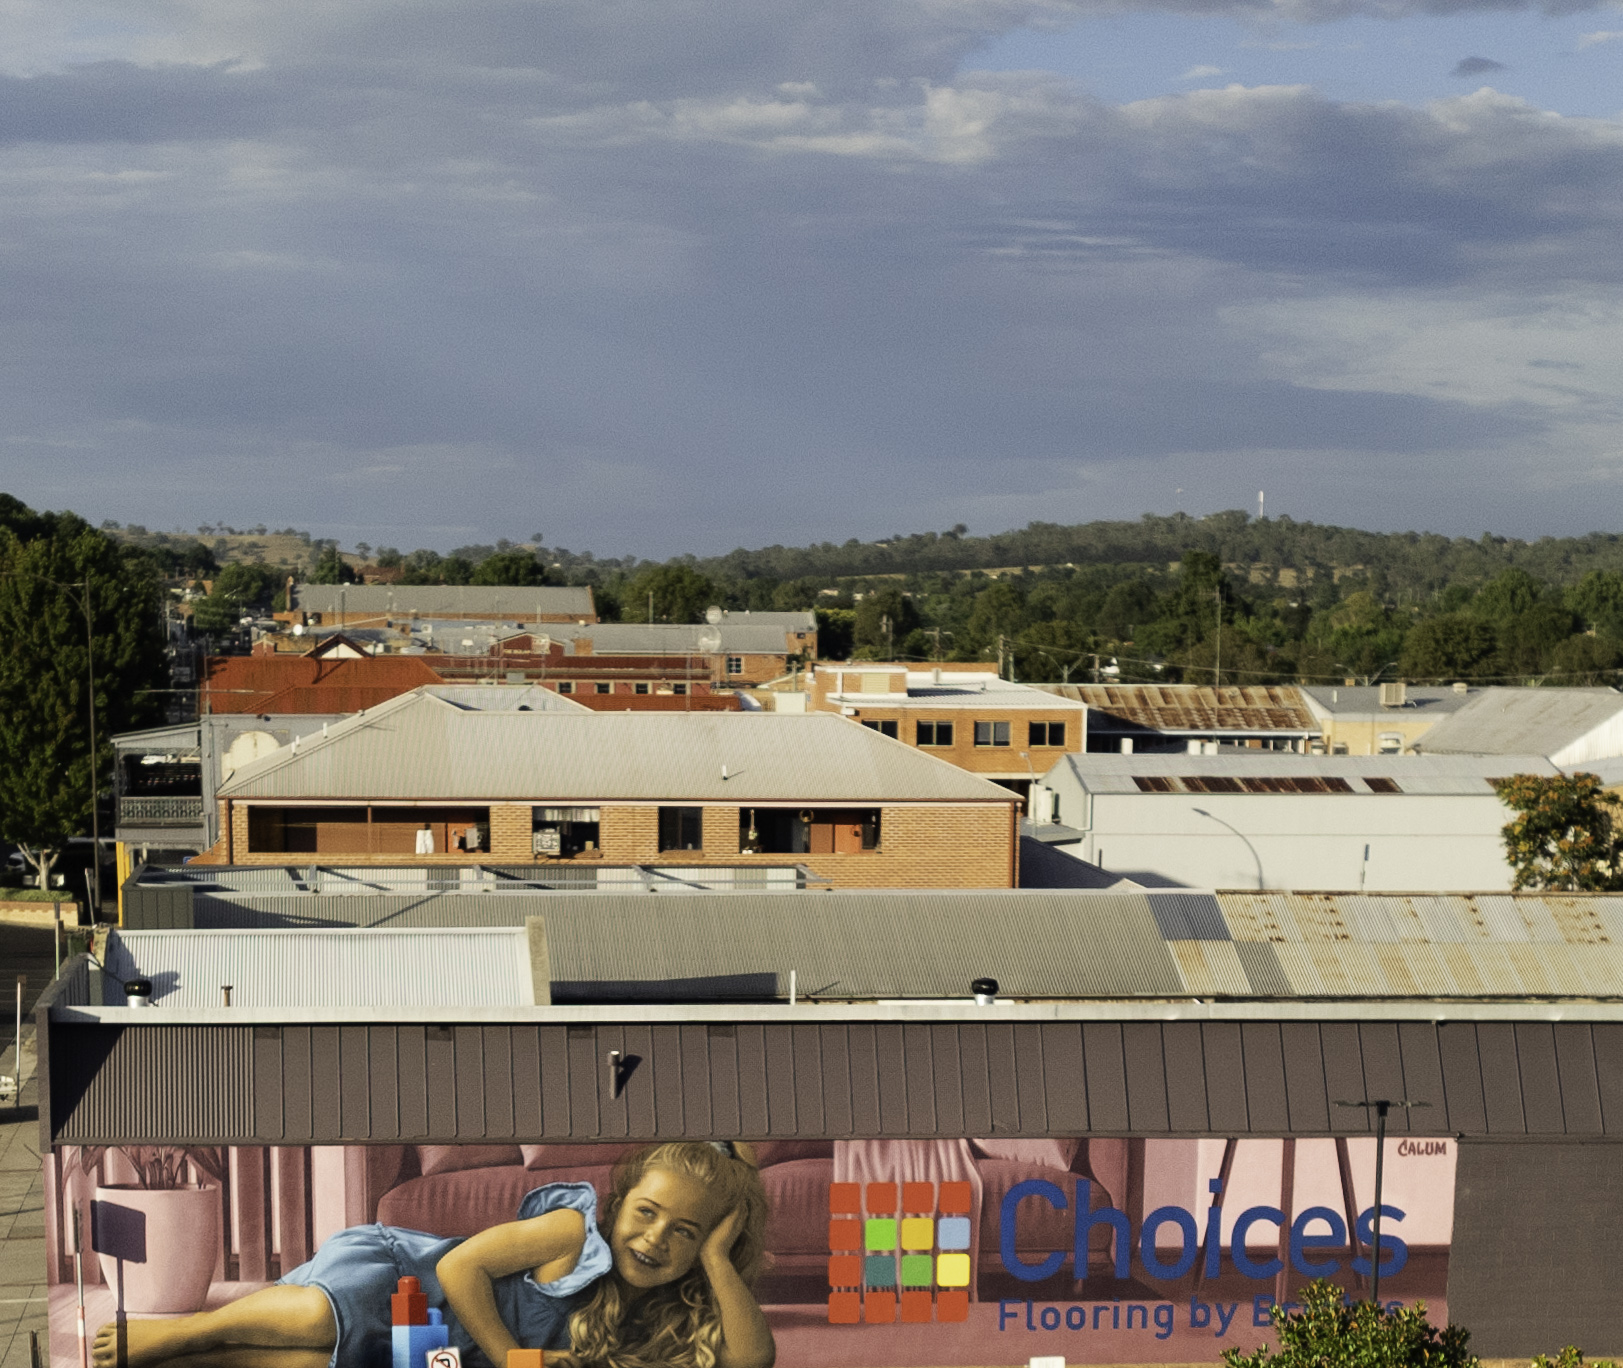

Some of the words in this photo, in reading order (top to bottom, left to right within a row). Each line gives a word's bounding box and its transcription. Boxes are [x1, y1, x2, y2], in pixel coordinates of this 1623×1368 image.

[1397, 1140, 1447, 1157] CALUM
[999, 1178, 1410, 1282] Choices
[999, 1298, 1174, 1339] Flooring
[1189, 1294, 1241, 1338] by
